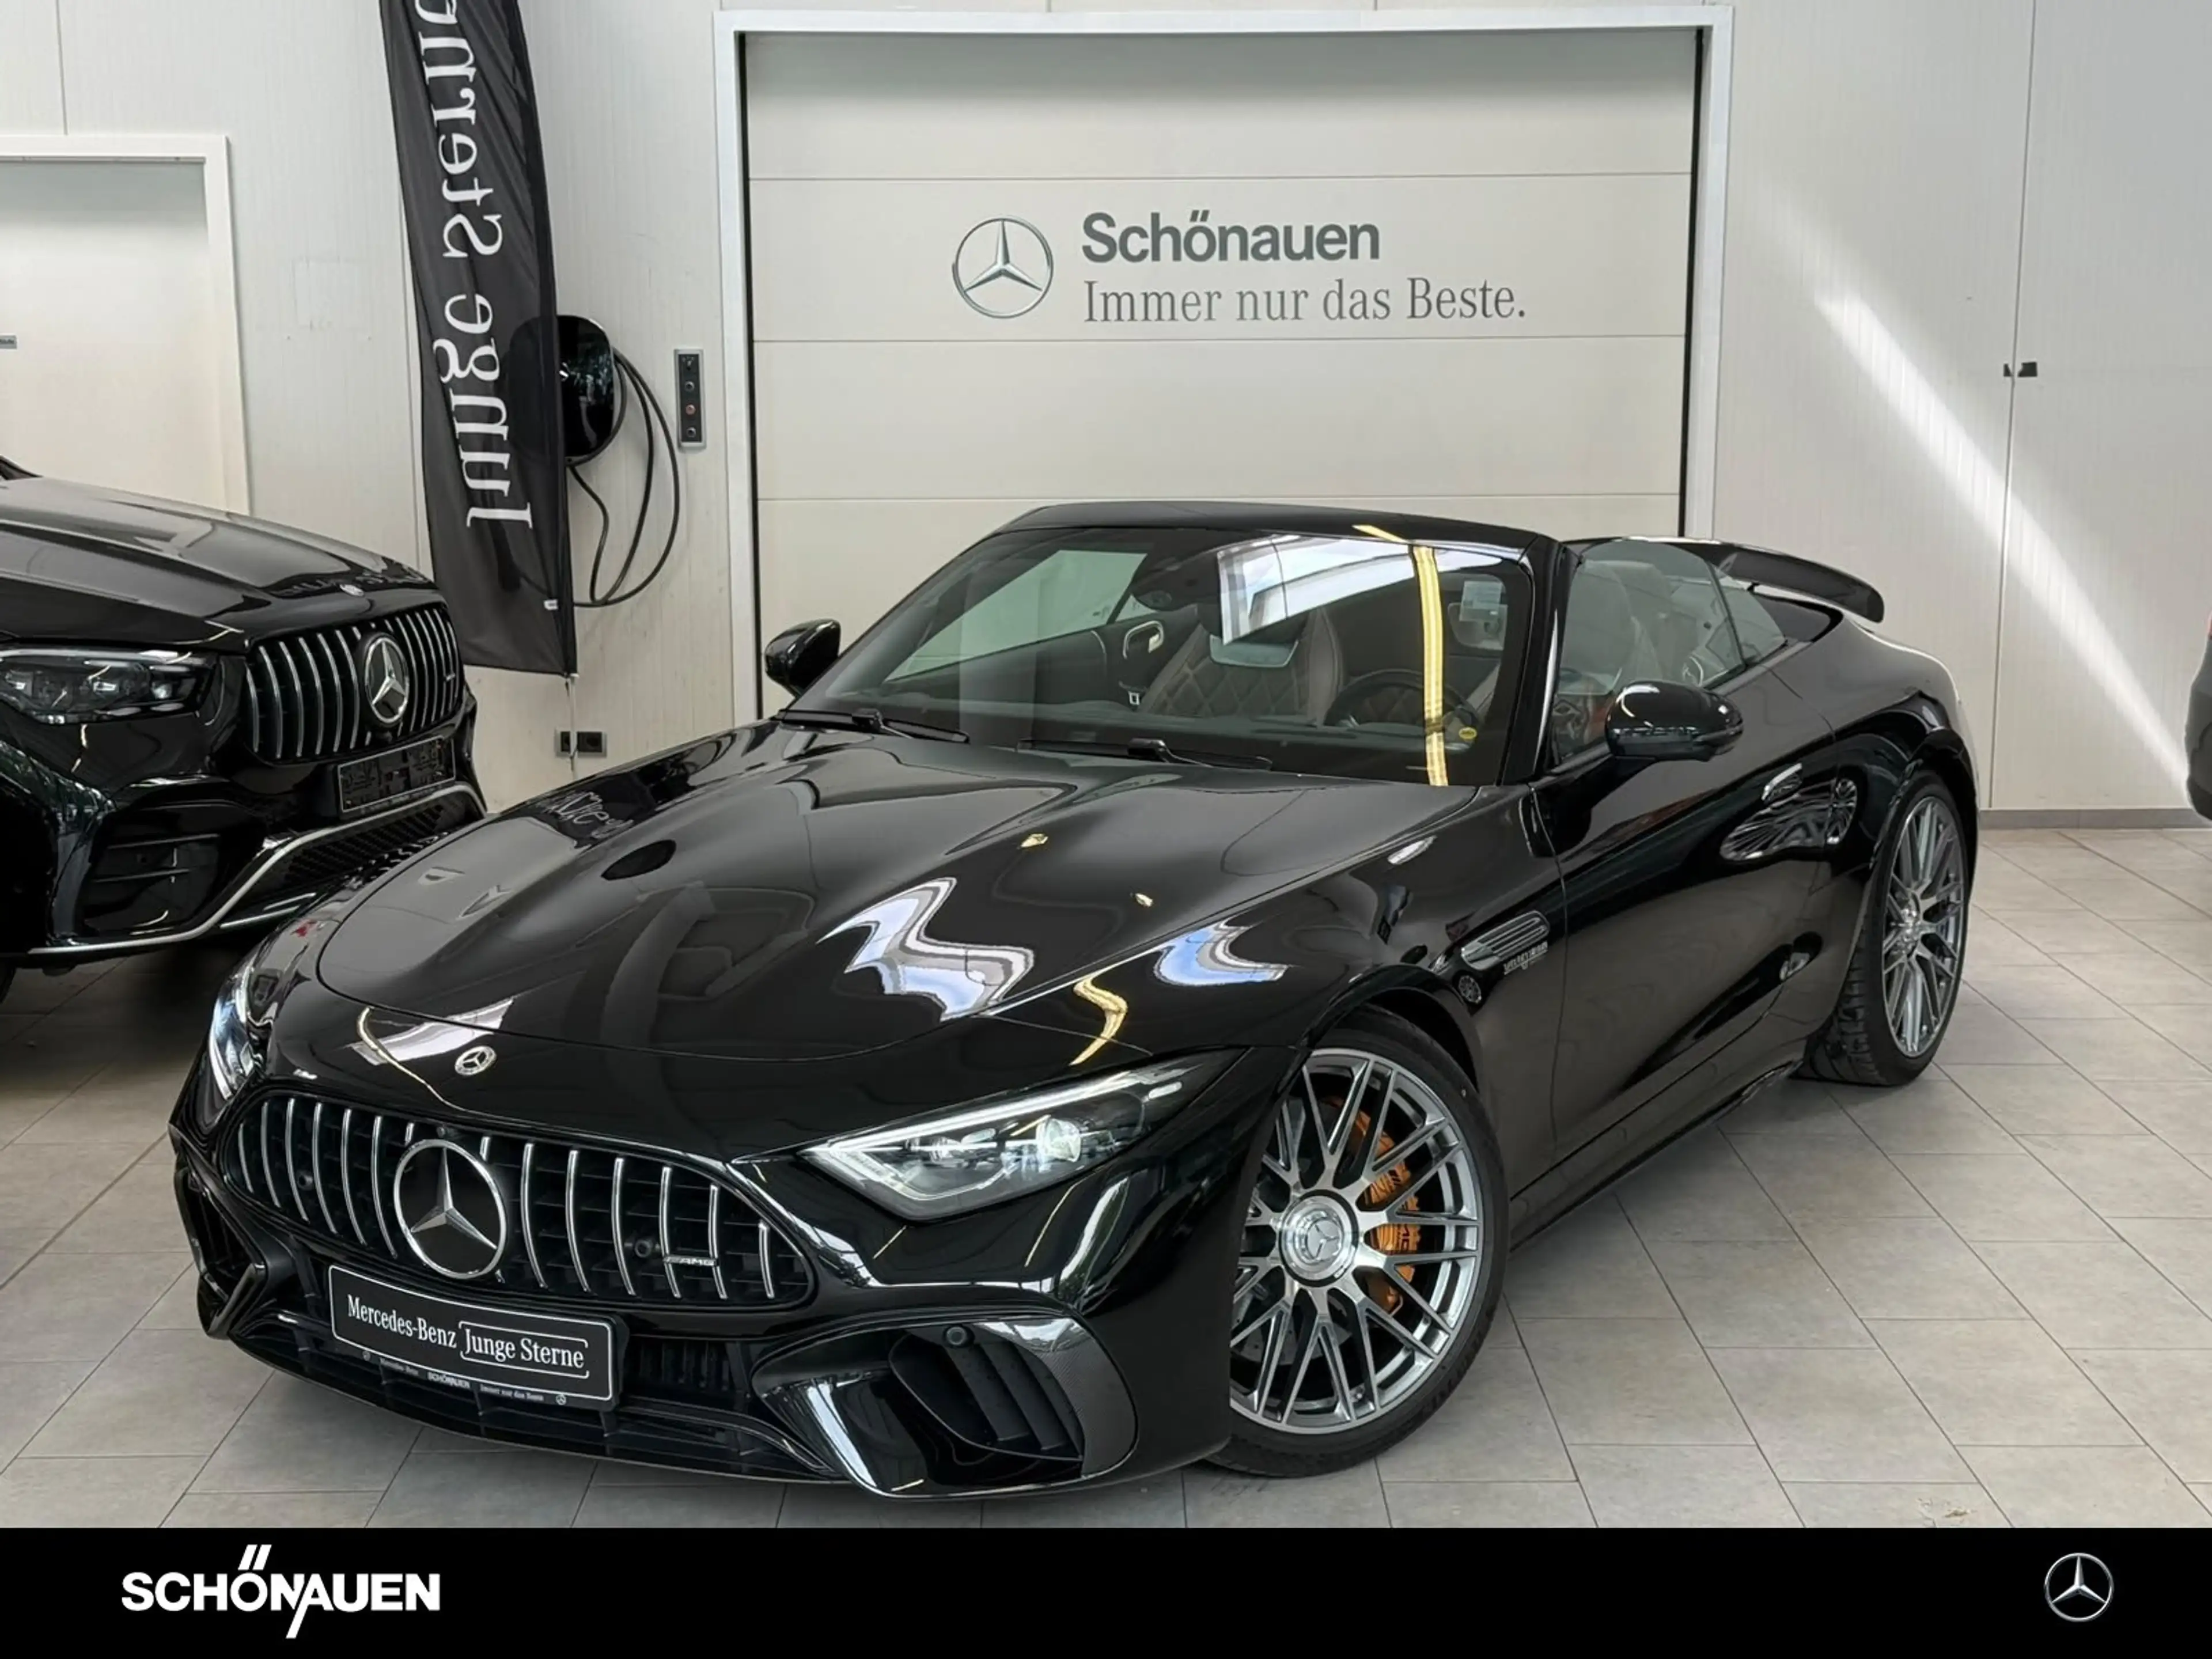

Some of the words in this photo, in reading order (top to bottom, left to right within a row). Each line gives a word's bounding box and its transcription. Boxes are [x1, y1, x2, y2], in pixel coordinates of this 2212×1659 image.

[1082, 210, 1380, 263] Schönauen
[1084, 280, 1222, 322] Immer
[1236, 289, 1309, 321] nur
[1323, 278, 1391, 321] das
[1406, 276, 1526, 319] Beste.
[347, 1294, 457, 1349] Mercedes-Benz
[464, 1328, 516, 1362] Junge
[520, 1338, 584, 1369] Sterne
